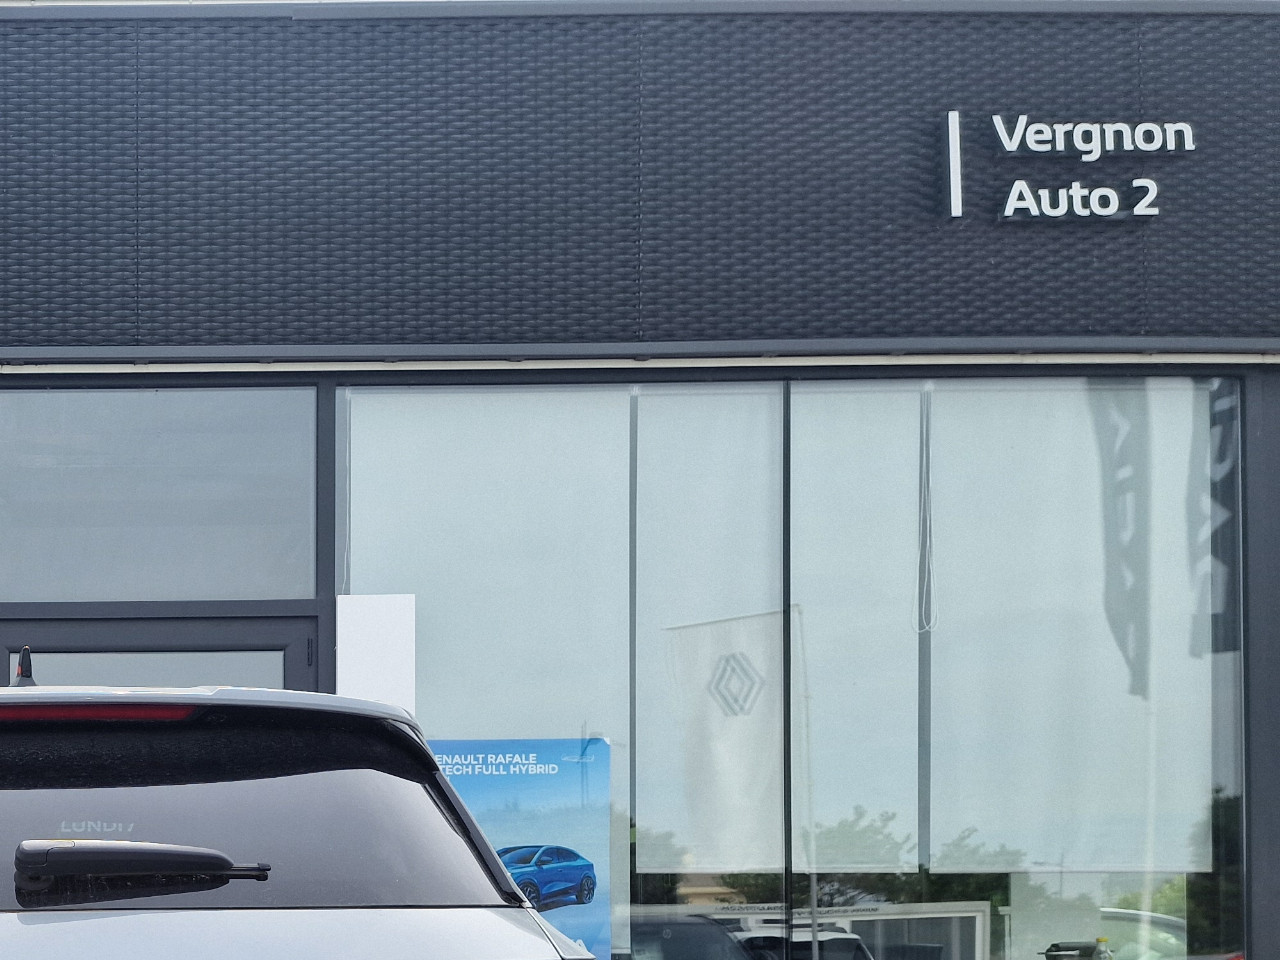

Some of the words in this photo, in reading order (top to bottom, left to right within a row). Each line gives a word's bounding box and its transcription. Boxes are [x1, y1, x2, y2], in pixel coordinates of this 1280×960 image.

[992, 114, 1196, 162] Vergnon
[1004, 180, 1119, 217] Auto
[1132, 178, 1160, 216] 2
[435, 754, 485, 765] ENAULT
[488, 753, 537, 764] RAFALE
[439, 764, 472, 775] TECH
[474, 764, 507, 775] FULL
[510, 764, 559, 774] HYBRID
